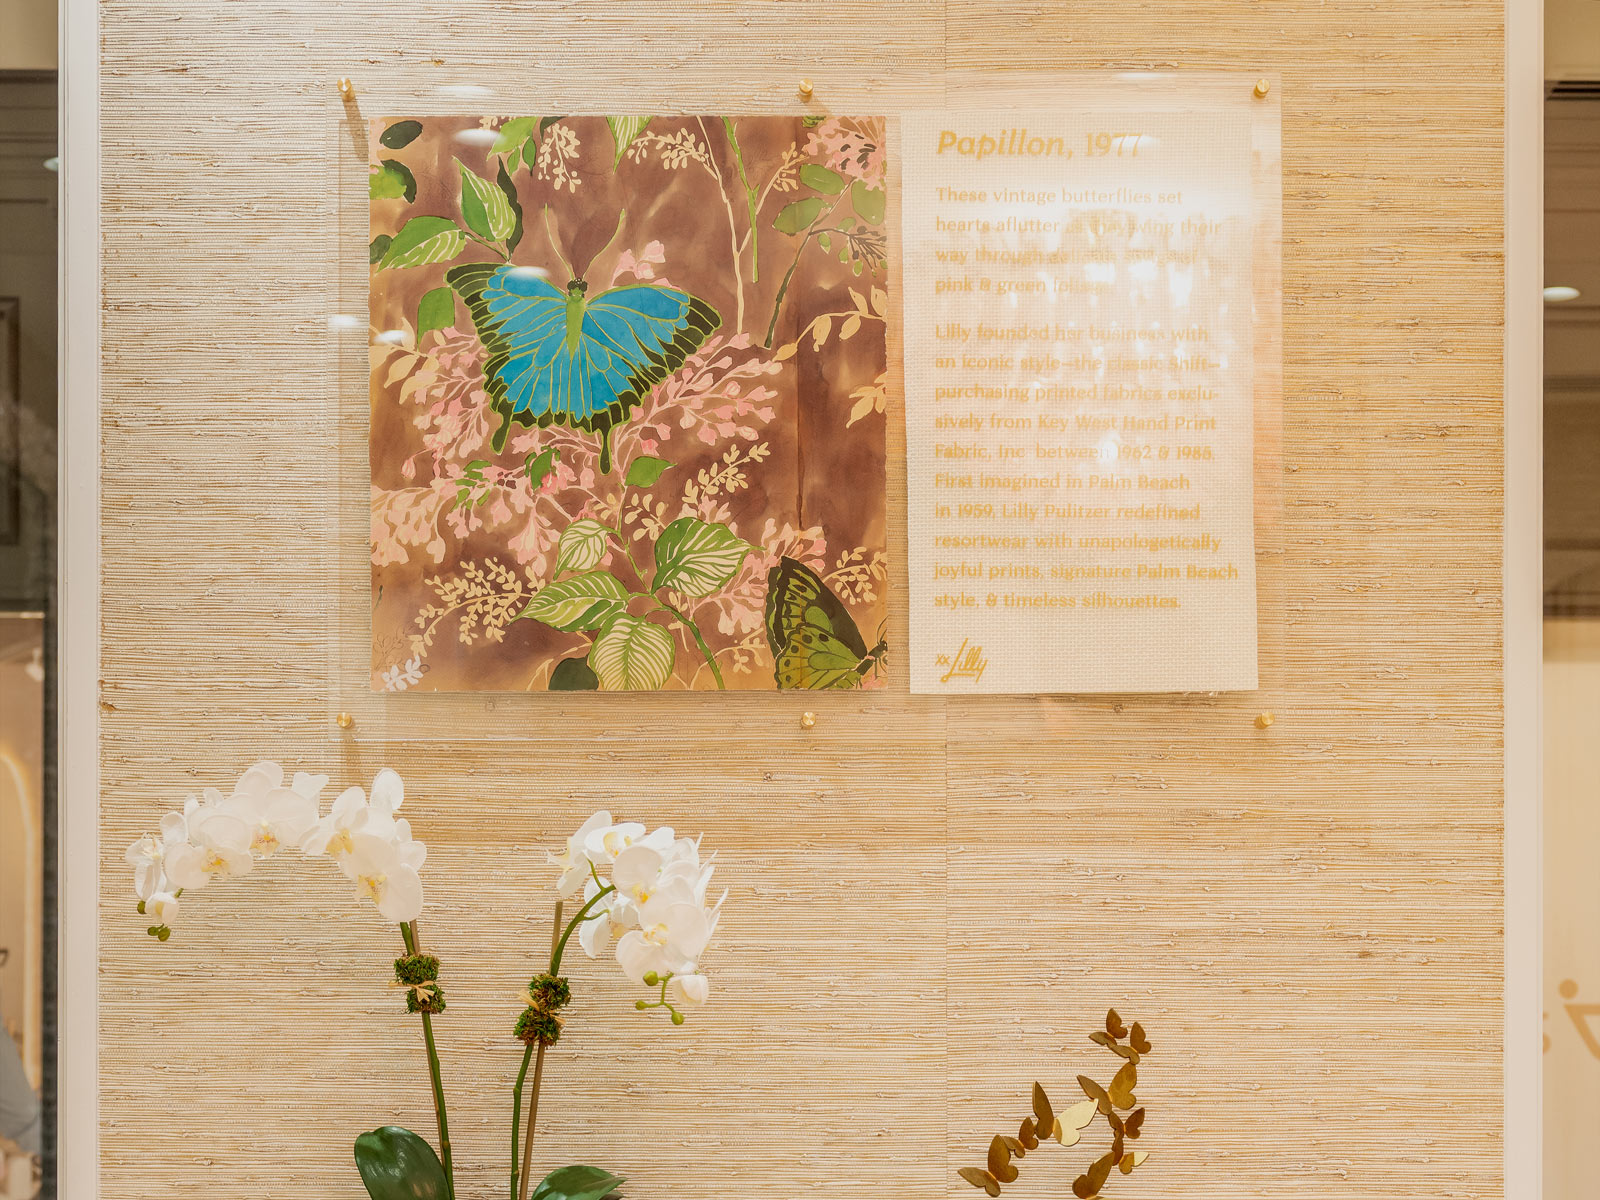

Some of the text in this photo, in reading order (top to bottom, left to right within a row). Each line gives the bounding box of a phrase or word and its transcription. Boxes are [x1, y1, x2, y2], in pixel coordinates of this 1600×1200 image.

[937, 129, 1143, 160] Papillon, 1977
[936, 187, 1183, 206] These vintage butterflies set
[936, 216, 990, 232] hearts
[995, 216, 1060, 232] aflutter
[1182, 216, 1222, 234] their
[936, 249, 968, 265] way
[976, 245, 1042, 266] through
[936, 274, 972, 294] pink
[979, 277, 991, 292] &
[997, 279, 1046, 296] green
[935, 325, 1208, 342] Lilly founded her business with
[935, 357, 956, 369] an
[962, 354, 1013, 369] iconic
[1107, 356, 1162, 370] classic
[935, 385, 1219, 402] purchasing printed fabrics exclu-
[935, 414, 1216, 432] sively from Key West Hand Print
[935, 444, 992, 461] Fabric,
[1036, 444, 1110, 460] between
[1117, 446, 1151, 460] 1962
[1158, 446, 1169, 460] &
[935, 474, 1189, 492] First imagined in Palm Beach
[935, 504, 1200, 522] in 1959, Lilly Pulitzer redefined
[935, 533, 1221, 553] resortwear with unapologetically
[933, 562, 1238, 581] joyful prints, signature Palm Beach
[934, 593, 1181, 610] style, & timeless silhouettes.
[941, 638, 988, 683] Lilly
